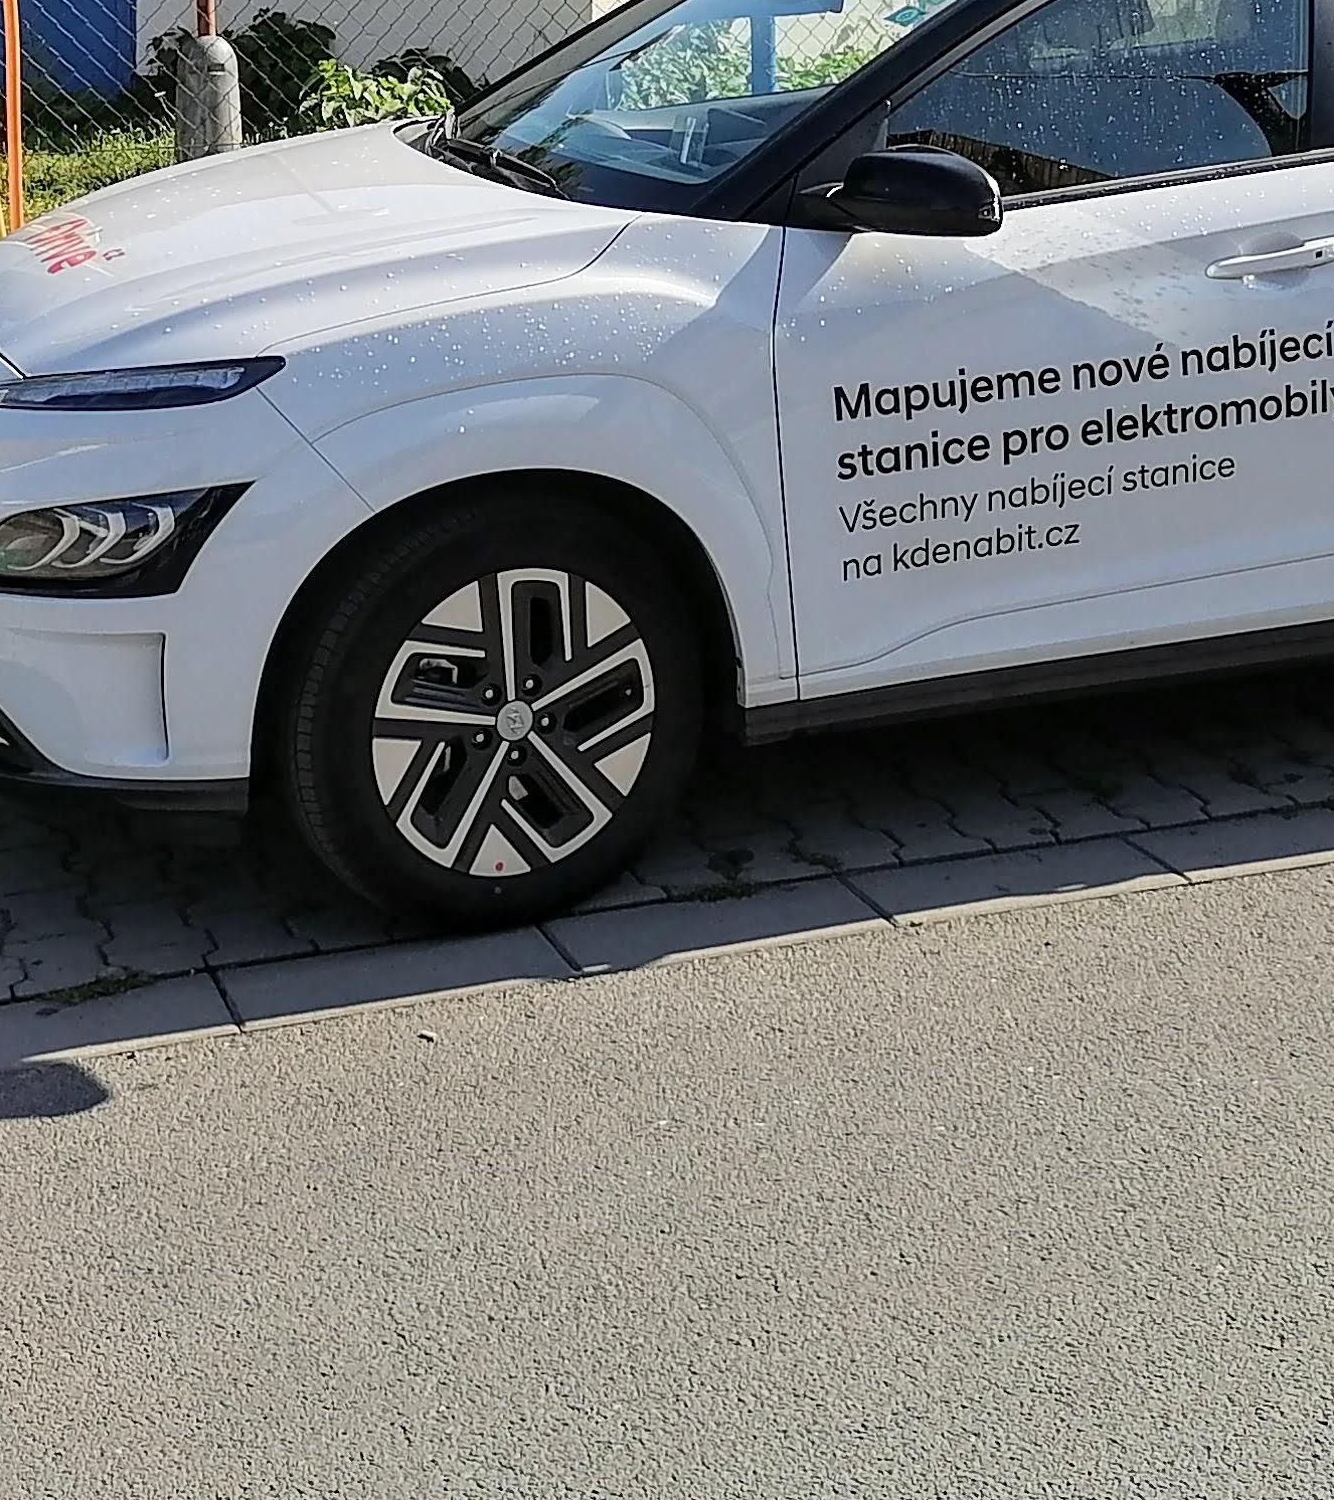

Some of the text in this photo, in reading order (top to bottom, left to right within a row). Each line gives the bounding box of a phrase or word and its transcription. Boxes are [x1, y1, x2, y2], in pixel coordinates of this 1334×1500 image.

[832, 320, 1334, 423] Mapujeme nové nabíjecí
[836, 429, 991, 481] stanice
[1002, 424, 1070, 467] pro
[838, 453, 1237, 534] Všechny nabíjecí stanice
[842, 520, 1082, 583] na kdenabit.cz
